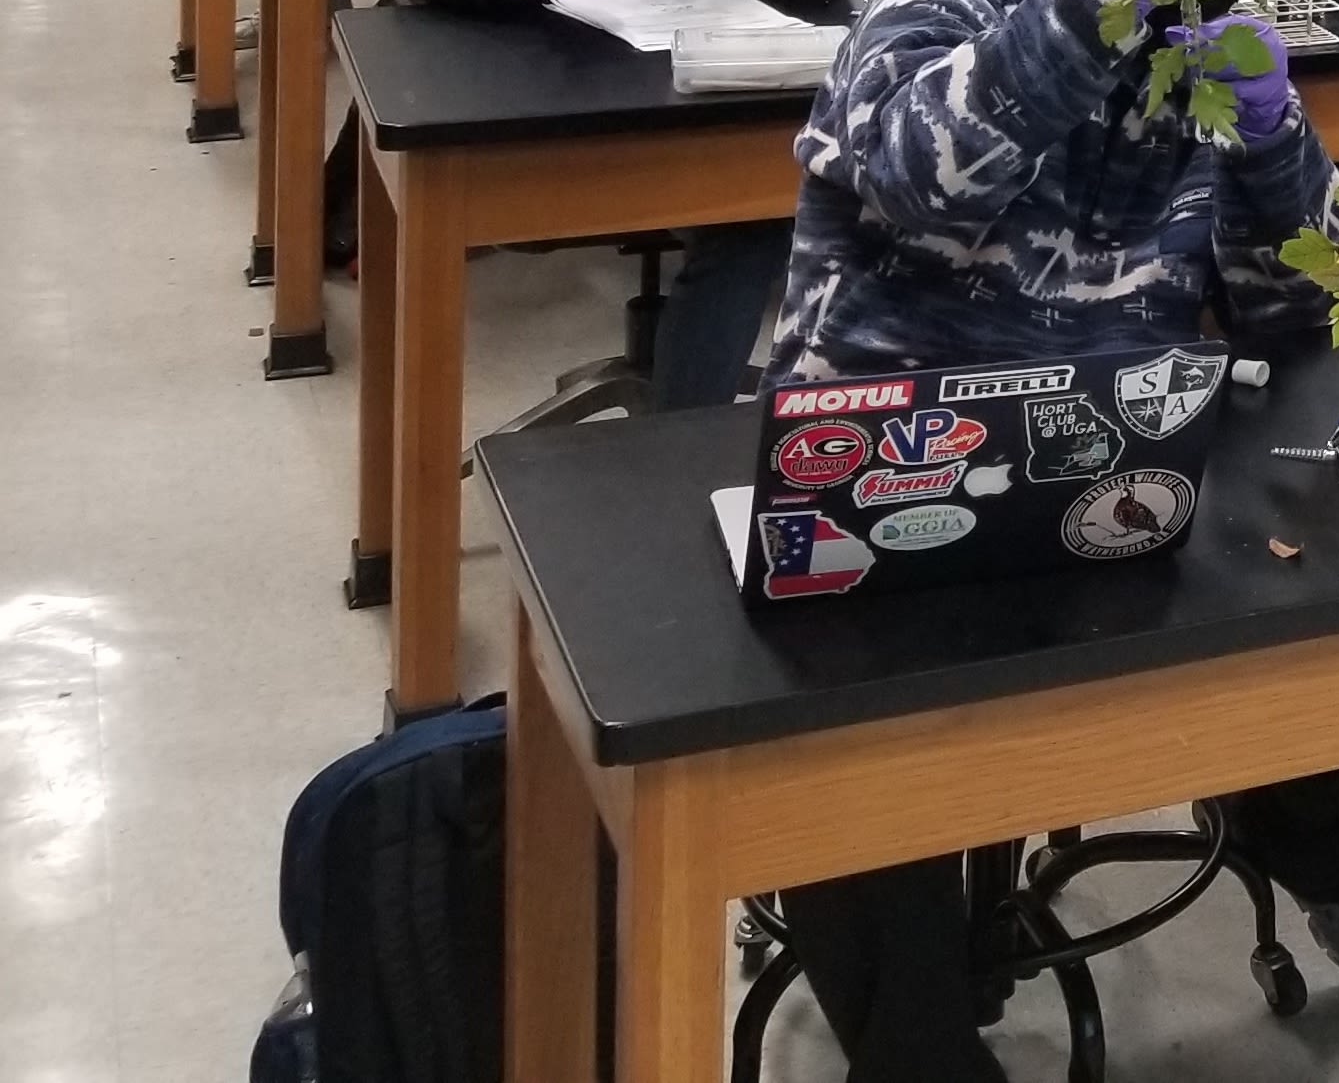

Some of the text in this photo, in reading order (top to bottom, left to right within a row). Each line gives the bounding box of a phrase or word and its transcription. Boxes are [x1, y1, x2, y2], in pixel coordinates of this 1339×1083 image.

[943, 368, 1070, 398] PIRELLI
[1139, 372, 1160, 394] S
[778, 385, 909, 414] MOTUL
[1032, 402, 1077, 417] HORT
[1167, 396, 1189, 416] A
[1038, 414, 1076, 428] CLUB
[1041, 421, 1097, 438] @ UGA
[884, 410, 956, 463] VP
[930, 431, 983, 453] Racing
[1084, 472, 1181, 502] PROTECT WILDLIFE
